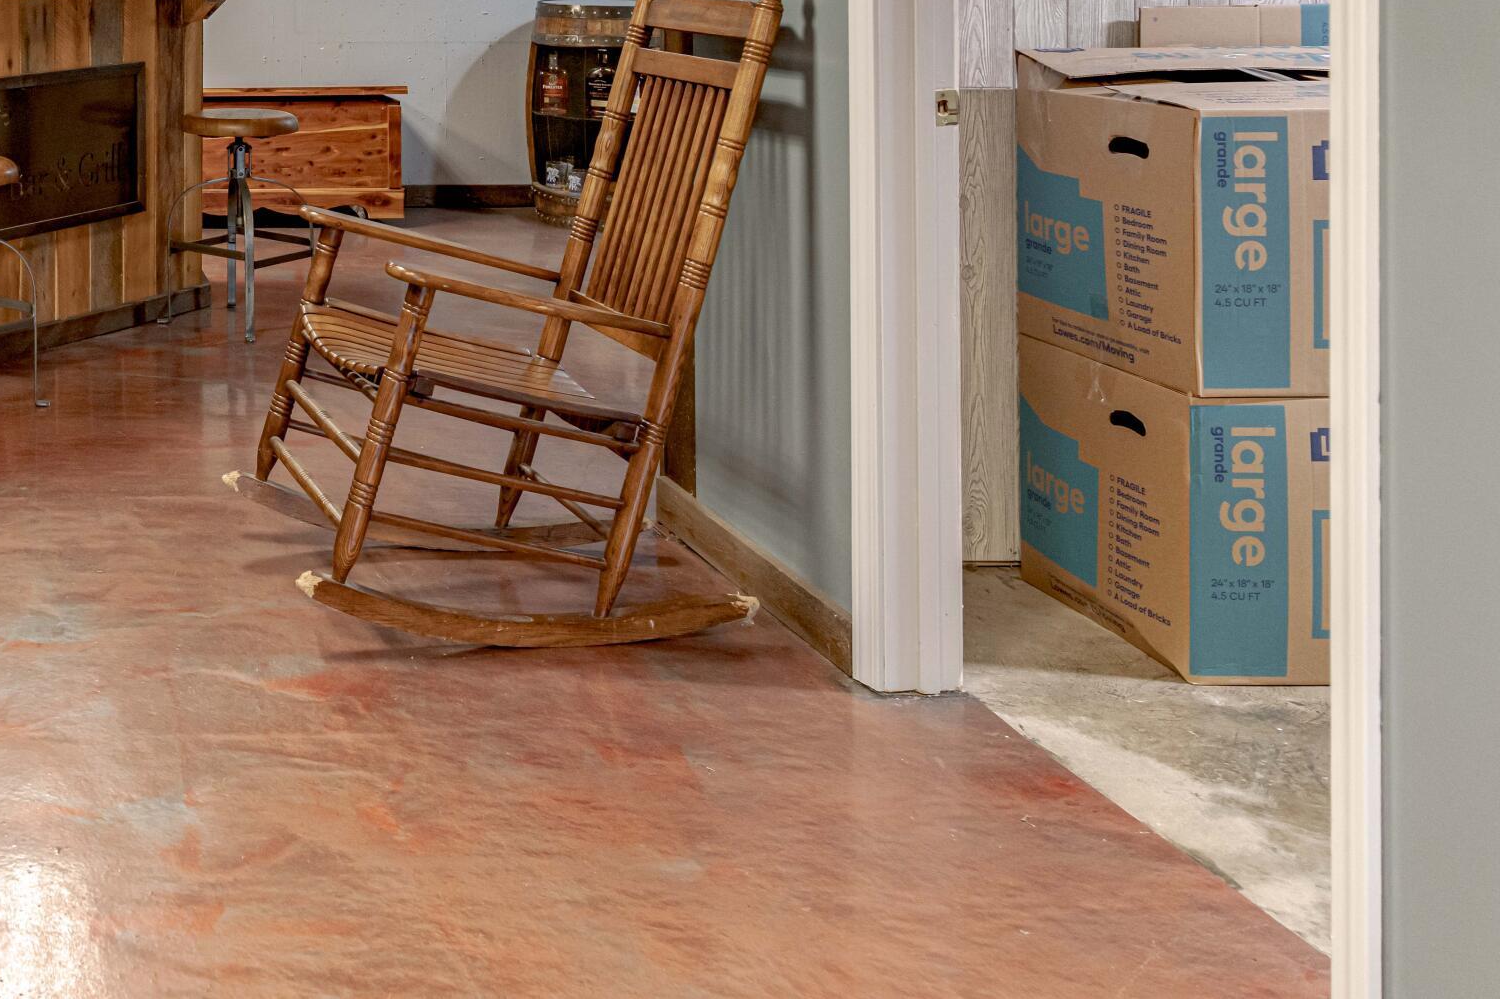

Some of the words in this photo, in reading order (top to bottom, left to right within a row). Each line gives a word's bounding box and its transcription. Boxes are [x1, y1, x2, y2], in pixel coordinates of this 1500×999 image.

[1213, 131, 1230, 188] grande
[1222, 131, 1279, 271] large
[1122, 205, 1152, 218] FRAGILE
[1025, 200, 1090, 255] large
[1122, 217, 1154, 230] Bedroom
[1123, 229, 1145, 241] Family
[1146, 234, 1167, 245] Room
[1026, 239, 1052, 255] grande
[1123, 240, 1145, 254] Dining
[1146, 245, 1167, 257] Room
[1123, 251, 1150, 265] Kitchen
[1124, 263, 1140, 273] Bath
[1124, 275, 1159, 290] Basement
[1214, 284, 1231, 294] 24"
[1241, 284, 1256, 294] 18"
[1266, 284, 1281, 293] 18"
[1125, 287, 1141, 297] Attic
[1125, 297, 1154, 313] Laundry
[1214, 298, 1231, 307] 4.5
[1234, 298, 1251, 307] CU
[1253, 298, 1267, 307] FT
[1126, 310, 1152, 324] Garage
[1134, 325, 1151, 335] Load
[1160, 331, 1182, 344] Bricks
[1052, 323, 1135, 364] Lowes.com/Moving
[1211, 426, 1228, 483] grande
[1027, 451, 1085, 514] large
[1117, 477, 1146, 495] FRAGILE
[1117, 489, 1147, 508] Bedroom
[1219, 427, 1276, 567] large
[1117, 500, 1138, 517] Family
[1140, 511, 1160, 525] Room
[1116, 523, 1142, 541] Kitchen
[1117, 512, 1138, 528] Dining
[1139, 522, 1159, 536] Room
[1116, 535, 1131, 548] Bath
[1115, 547, 1150, 568] Basement
[1116, 559, 1131, 571] Attic
[1115, 569, 1143, 589] Laundry
[1211, 579, 1228, 588] 24"
[1237, 579, 1251, 588] 18"
[1261, 580, 1275, 589] 18"
[1115, 581, 1140, 599] Garage
[1211, 592, 1227, 600] 4.5
[1229, 592, 1246, 601] CU
[1248, 592, 1261, 600] FT
[1120, 596, 1137, 610] Load
[1139, 607, 1147, 615] of
[1147, 610, 1171, 626] Bricks
